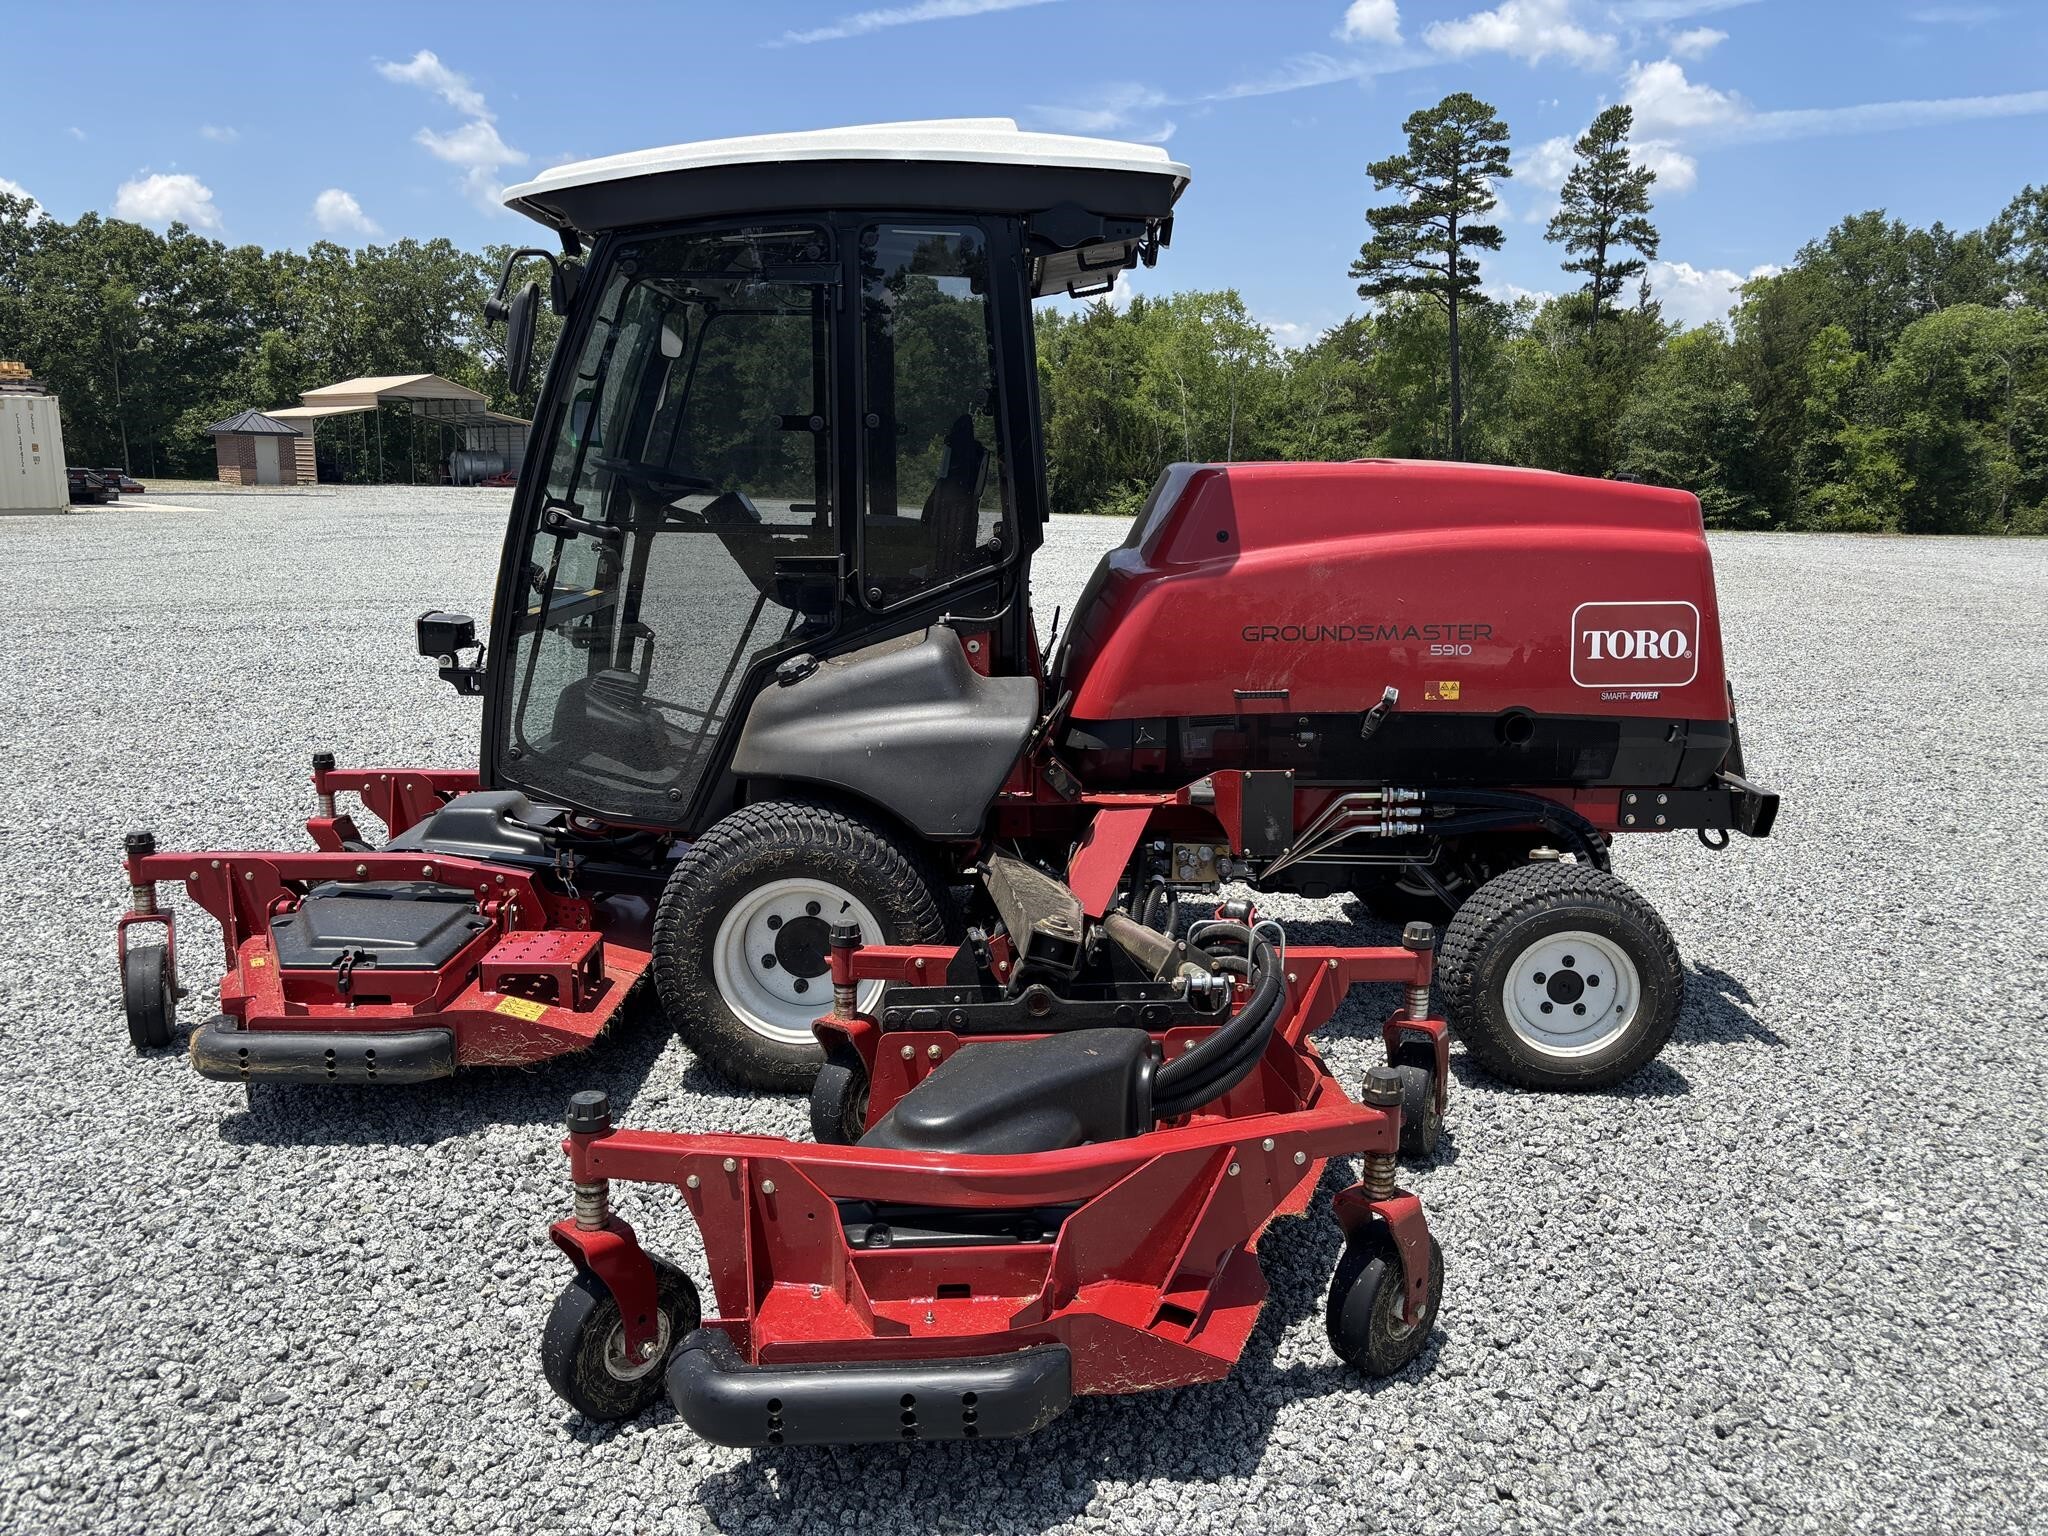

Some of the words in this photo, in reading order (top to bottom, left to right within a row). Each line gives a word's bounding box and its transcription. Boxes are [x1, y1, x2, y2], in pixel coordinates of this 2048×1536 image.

[1241, 624, 1492, 642] GROUNDSMASTER
[1430, 643, 1472, 656] 5910
[1630, 691, 1659, 700] POWER
